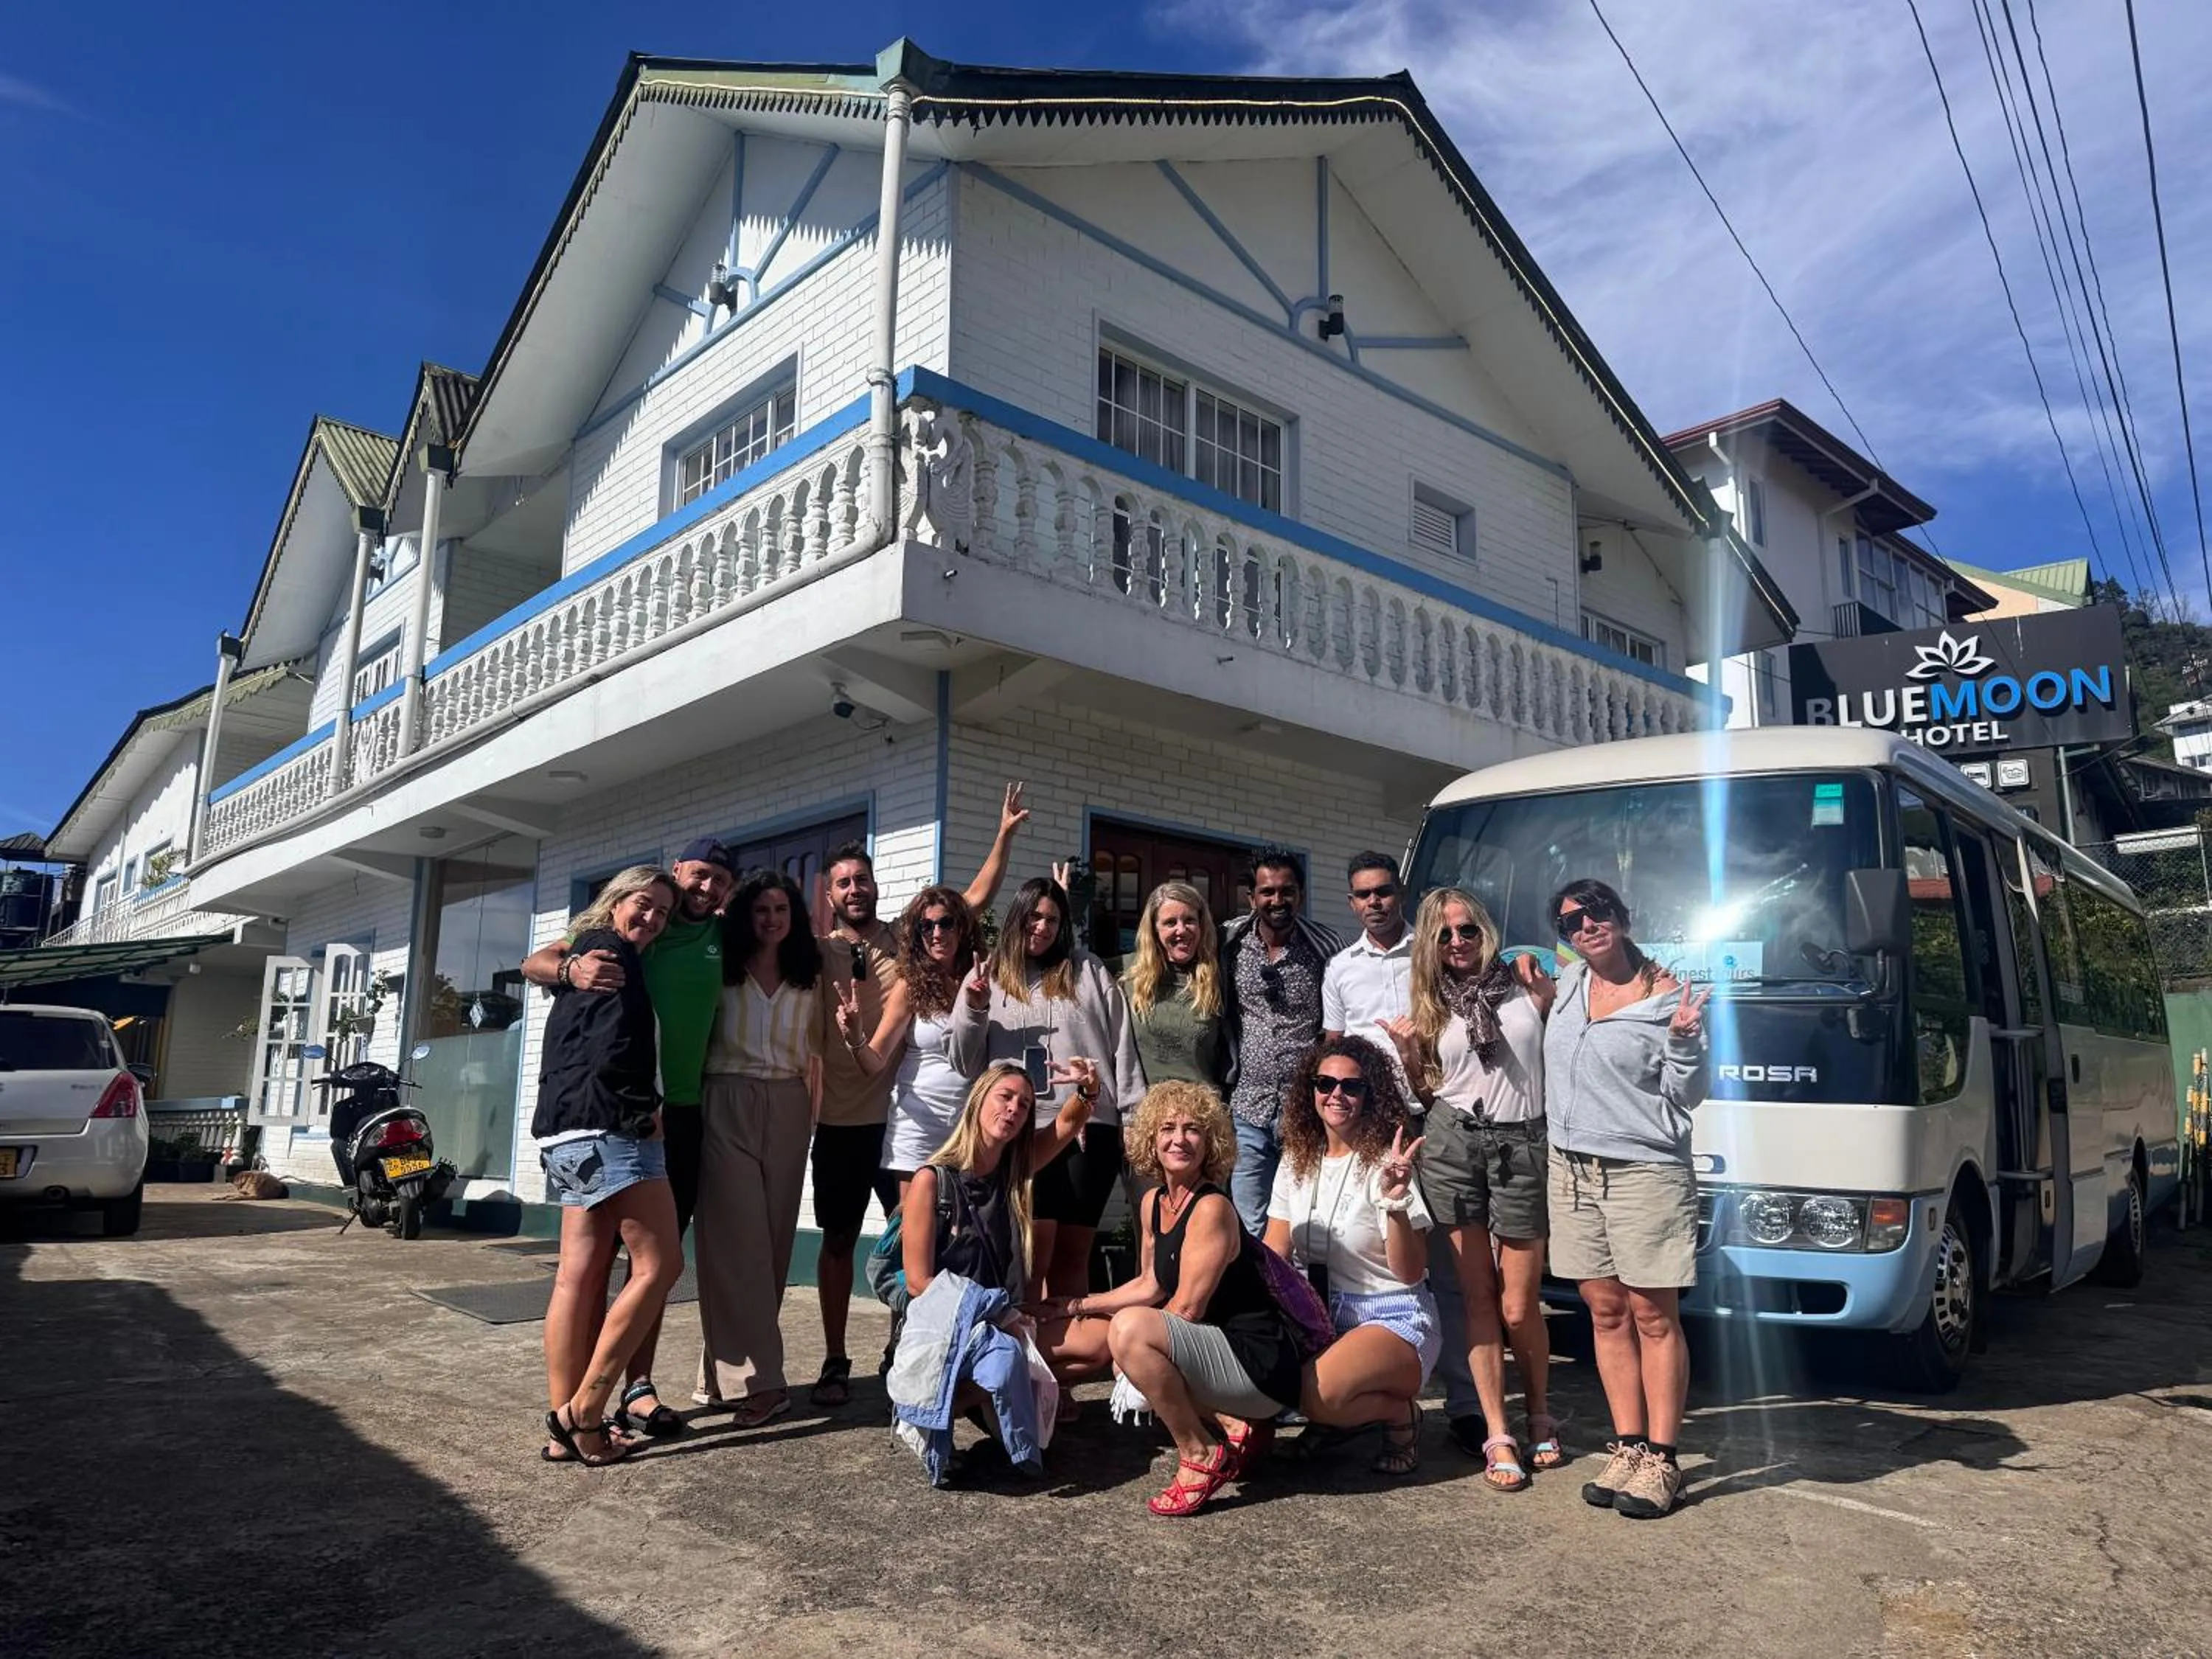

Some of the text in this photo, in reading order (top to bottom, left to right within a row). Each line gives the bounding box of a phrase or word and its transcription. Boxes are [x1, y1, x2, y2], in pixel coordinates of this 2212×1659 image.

[1902, 720, 2008, 745] HOTEL
[1669, 967, 1711, 980] inest
[1719, 1065, 1818, 1082] ROSA
